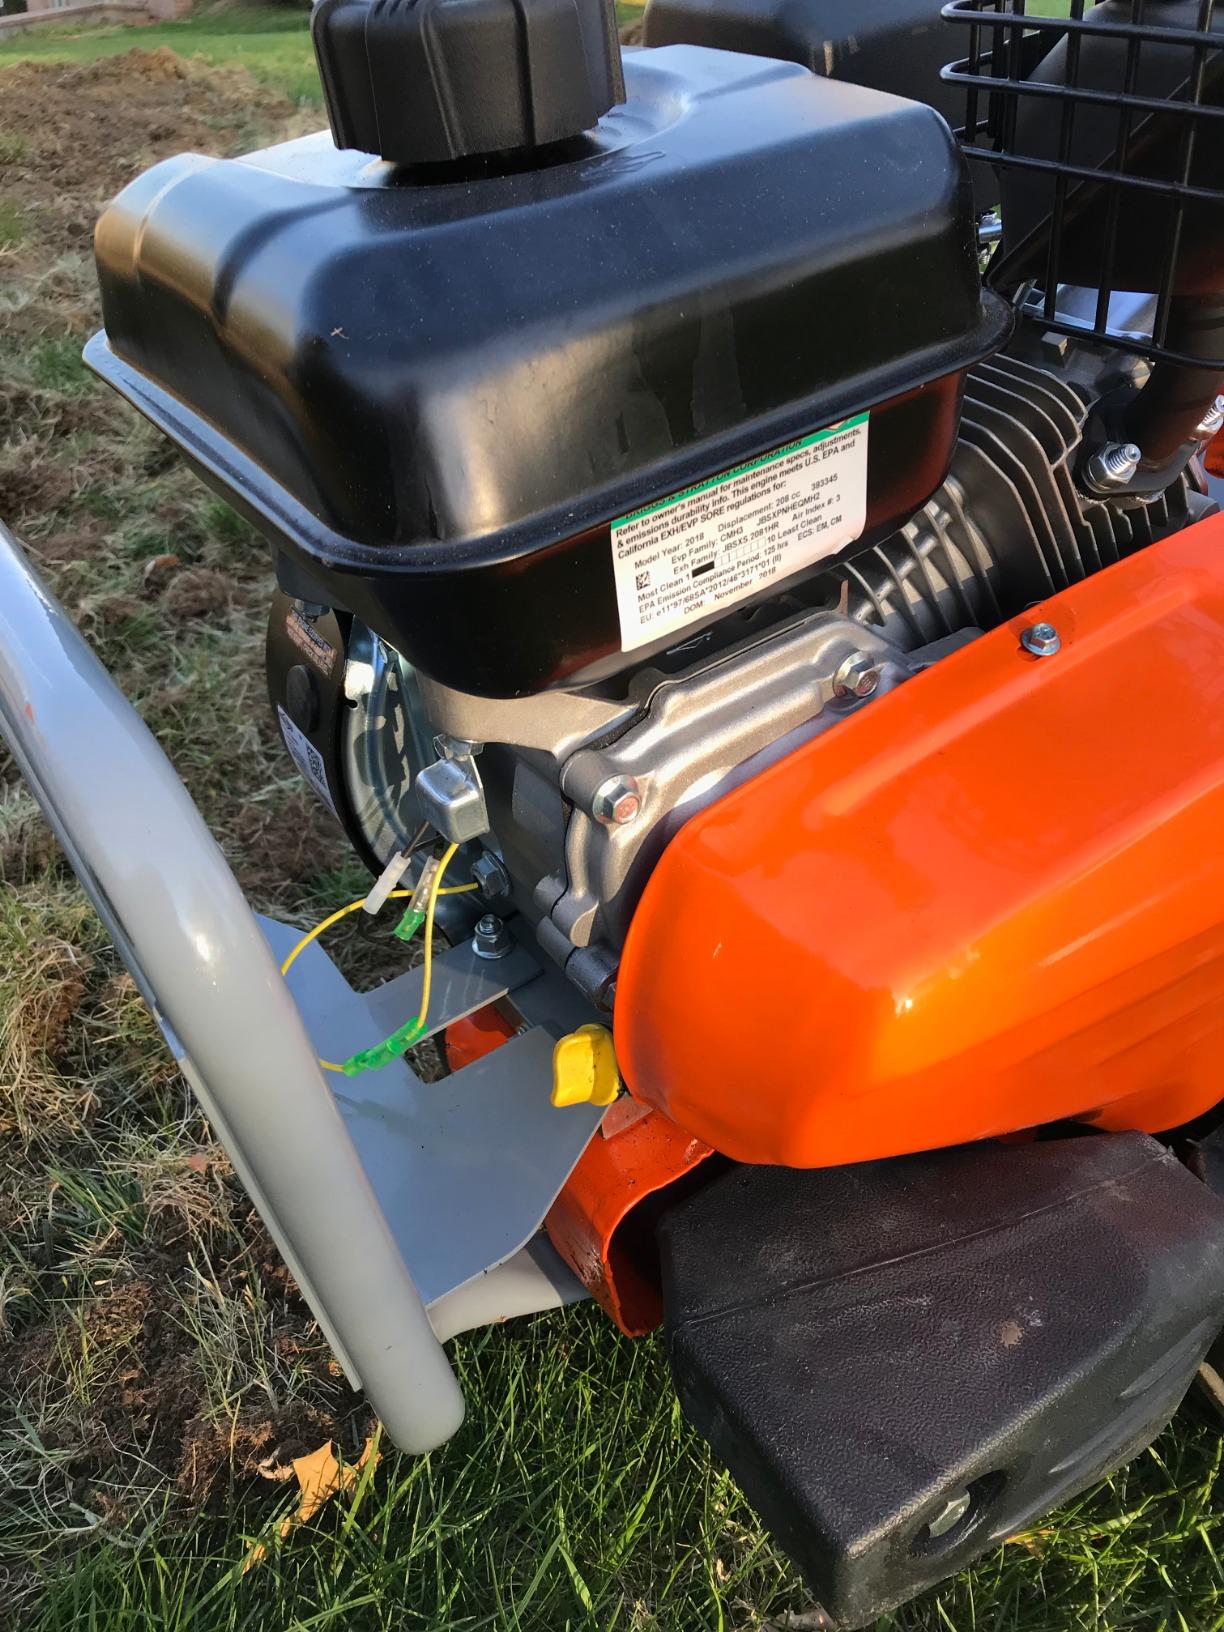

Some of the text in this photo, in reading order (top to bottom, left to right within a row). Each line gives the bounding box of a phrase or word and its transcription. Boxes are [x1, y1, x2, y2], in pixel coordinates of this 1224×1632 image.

[615, 520, 639, 538] Refer
[651, 501, 685, 522] owner's
[687, 486, 718, 507] manual
[720, 480, 731, 493] for
[733, 459, 783, 487] maintenance
[786, 447, 811, 466] specs,
[812, 425, 861, 455] adjustments,
[617, 478, 786, 560] California EXH/EVP SORE regulations for:
[625, 519, 669, 545] emissions
[671, 501, 710, 526] durability
[712, 493, 729, 507] info.
[732, 484, 748, 498] This
[750, 471, 778, 492] engine
[779, 461, 803, 478] meets
[805, 453, 820, 467] U.S.
[822, 445, 839, 459] EPA
[840, 438, 855, 451] and
[634, 551, 659, 570] Model
[661, 541, 681, 557] Year:
[685, 531, 704, 547] 2018
[717, 500, 773, 533] Displacement:
[775, 493, 789, 507] 208
[810, 471, 838, 492] 383345
[637, 586, 658, 603] Most
[659, 575, 683, 593] Clean
[777, 522, 798, 540] Least
[800, 511, 822, 529] Clean
[638, 598, 655, 614] EPA
[657, 582, 691, 605] Emission
[692, 562, 735, 590] Compliance
[764, 544, 775, 557] 125
[776, 537, 788, 551] hrs
[671, 550, 686, 566] Evp
[720, 525, 743, 543] CMH3
[673, 560, 689, 575] Exh
[791, 509, 803, 522] Air
[805, 500, 824, 516] Index
[714, 576, 752, 602] November
